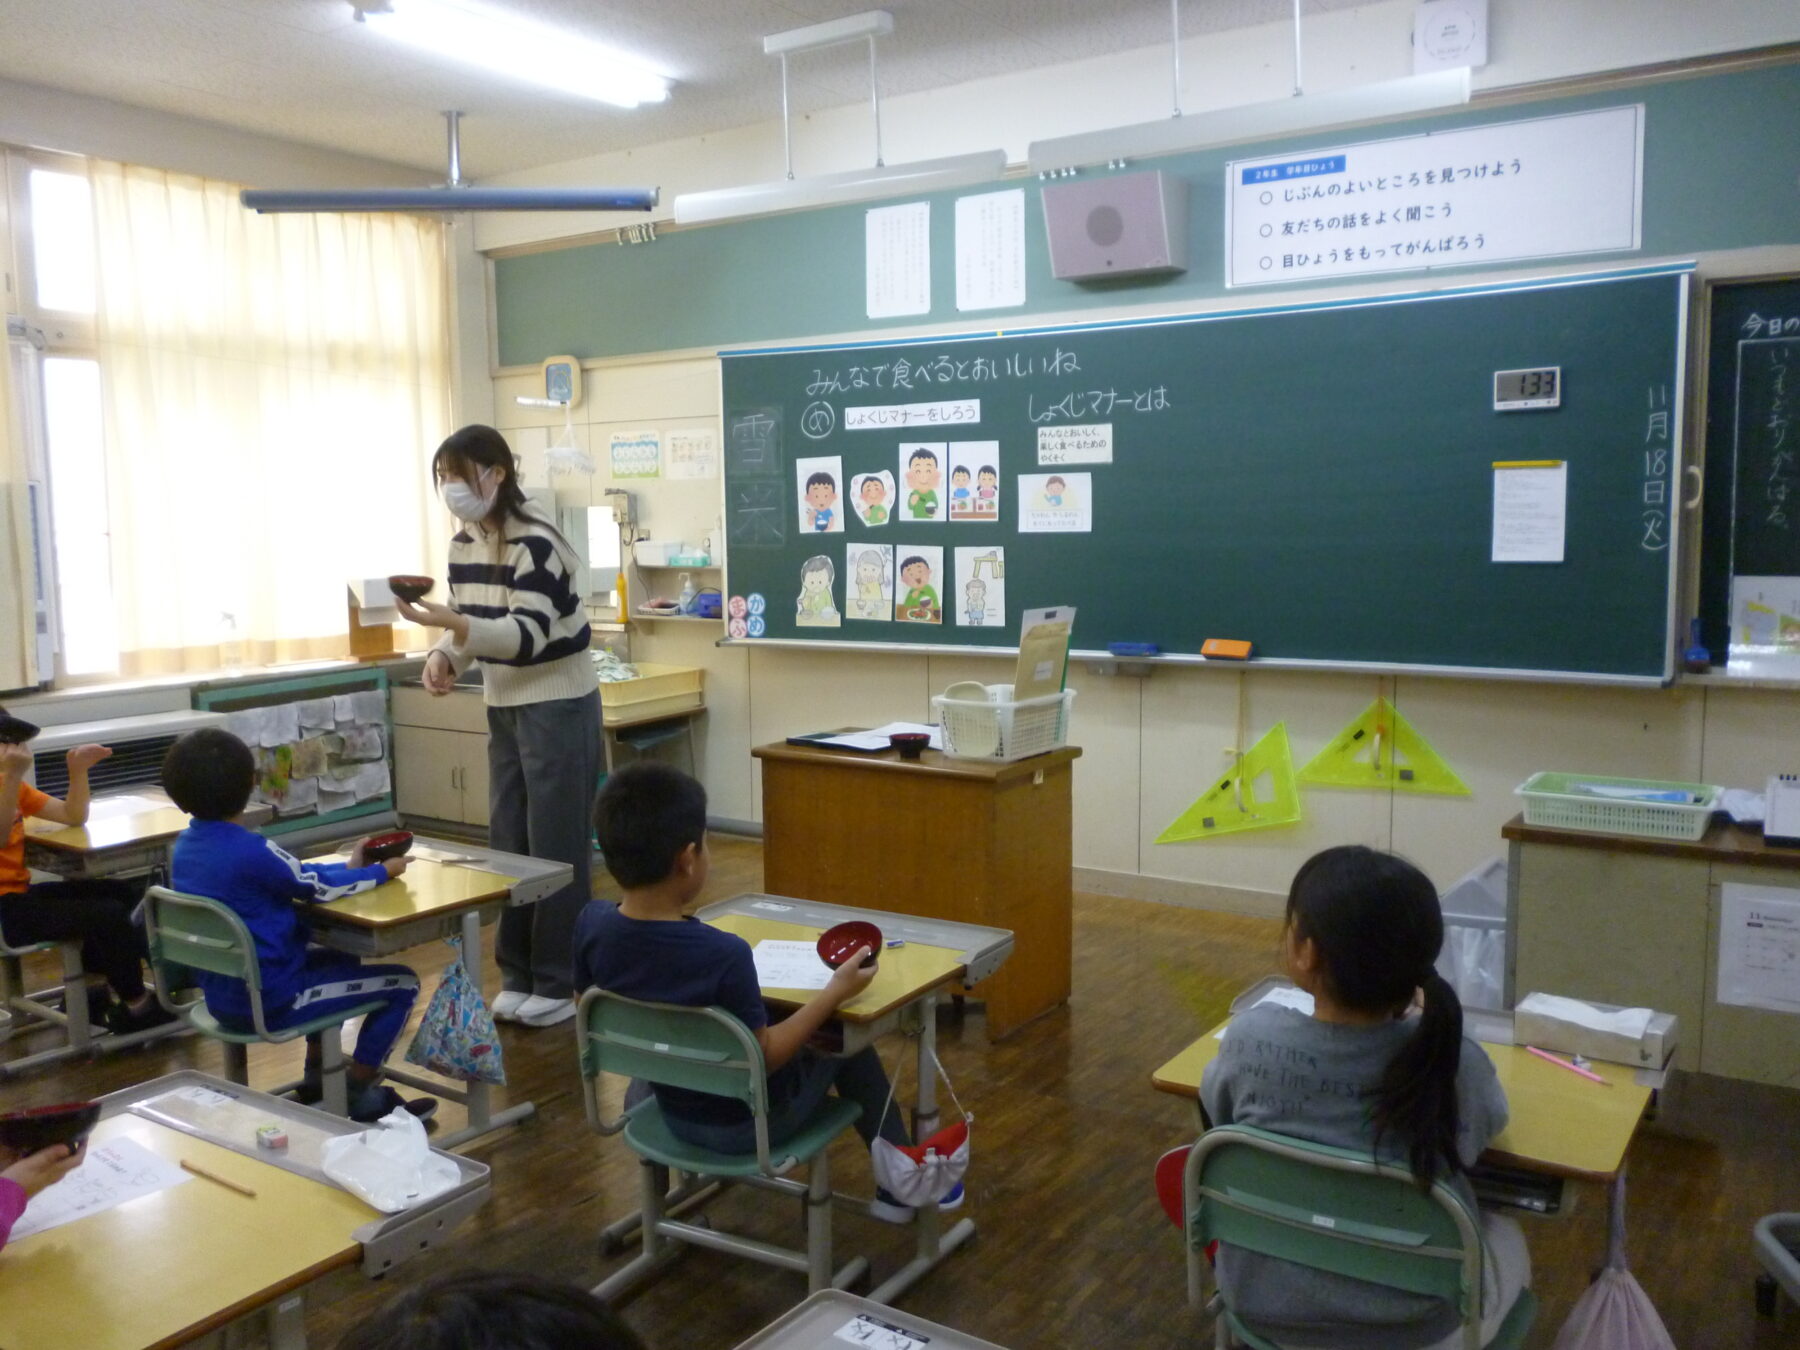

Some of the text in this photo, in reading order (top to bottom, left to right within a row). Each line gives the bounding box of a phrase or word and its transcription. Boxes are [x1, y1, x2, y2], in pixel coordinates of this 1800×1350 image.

[1283, 158, 1521, 202] じぶんのよいところを見つけよう
[1281, 202, 1452, 235] 友だちの話をよく聞こう
[1282, 233, 1485, 268] 目ひょうをもってがんばろう
[806, 347, 1081, 396] みんなで食べるとおいしいね
[846, 405, 976, 425] しょくじマナーをしろう
[1028, 385, 1171, 422] しょくじマナーとは
